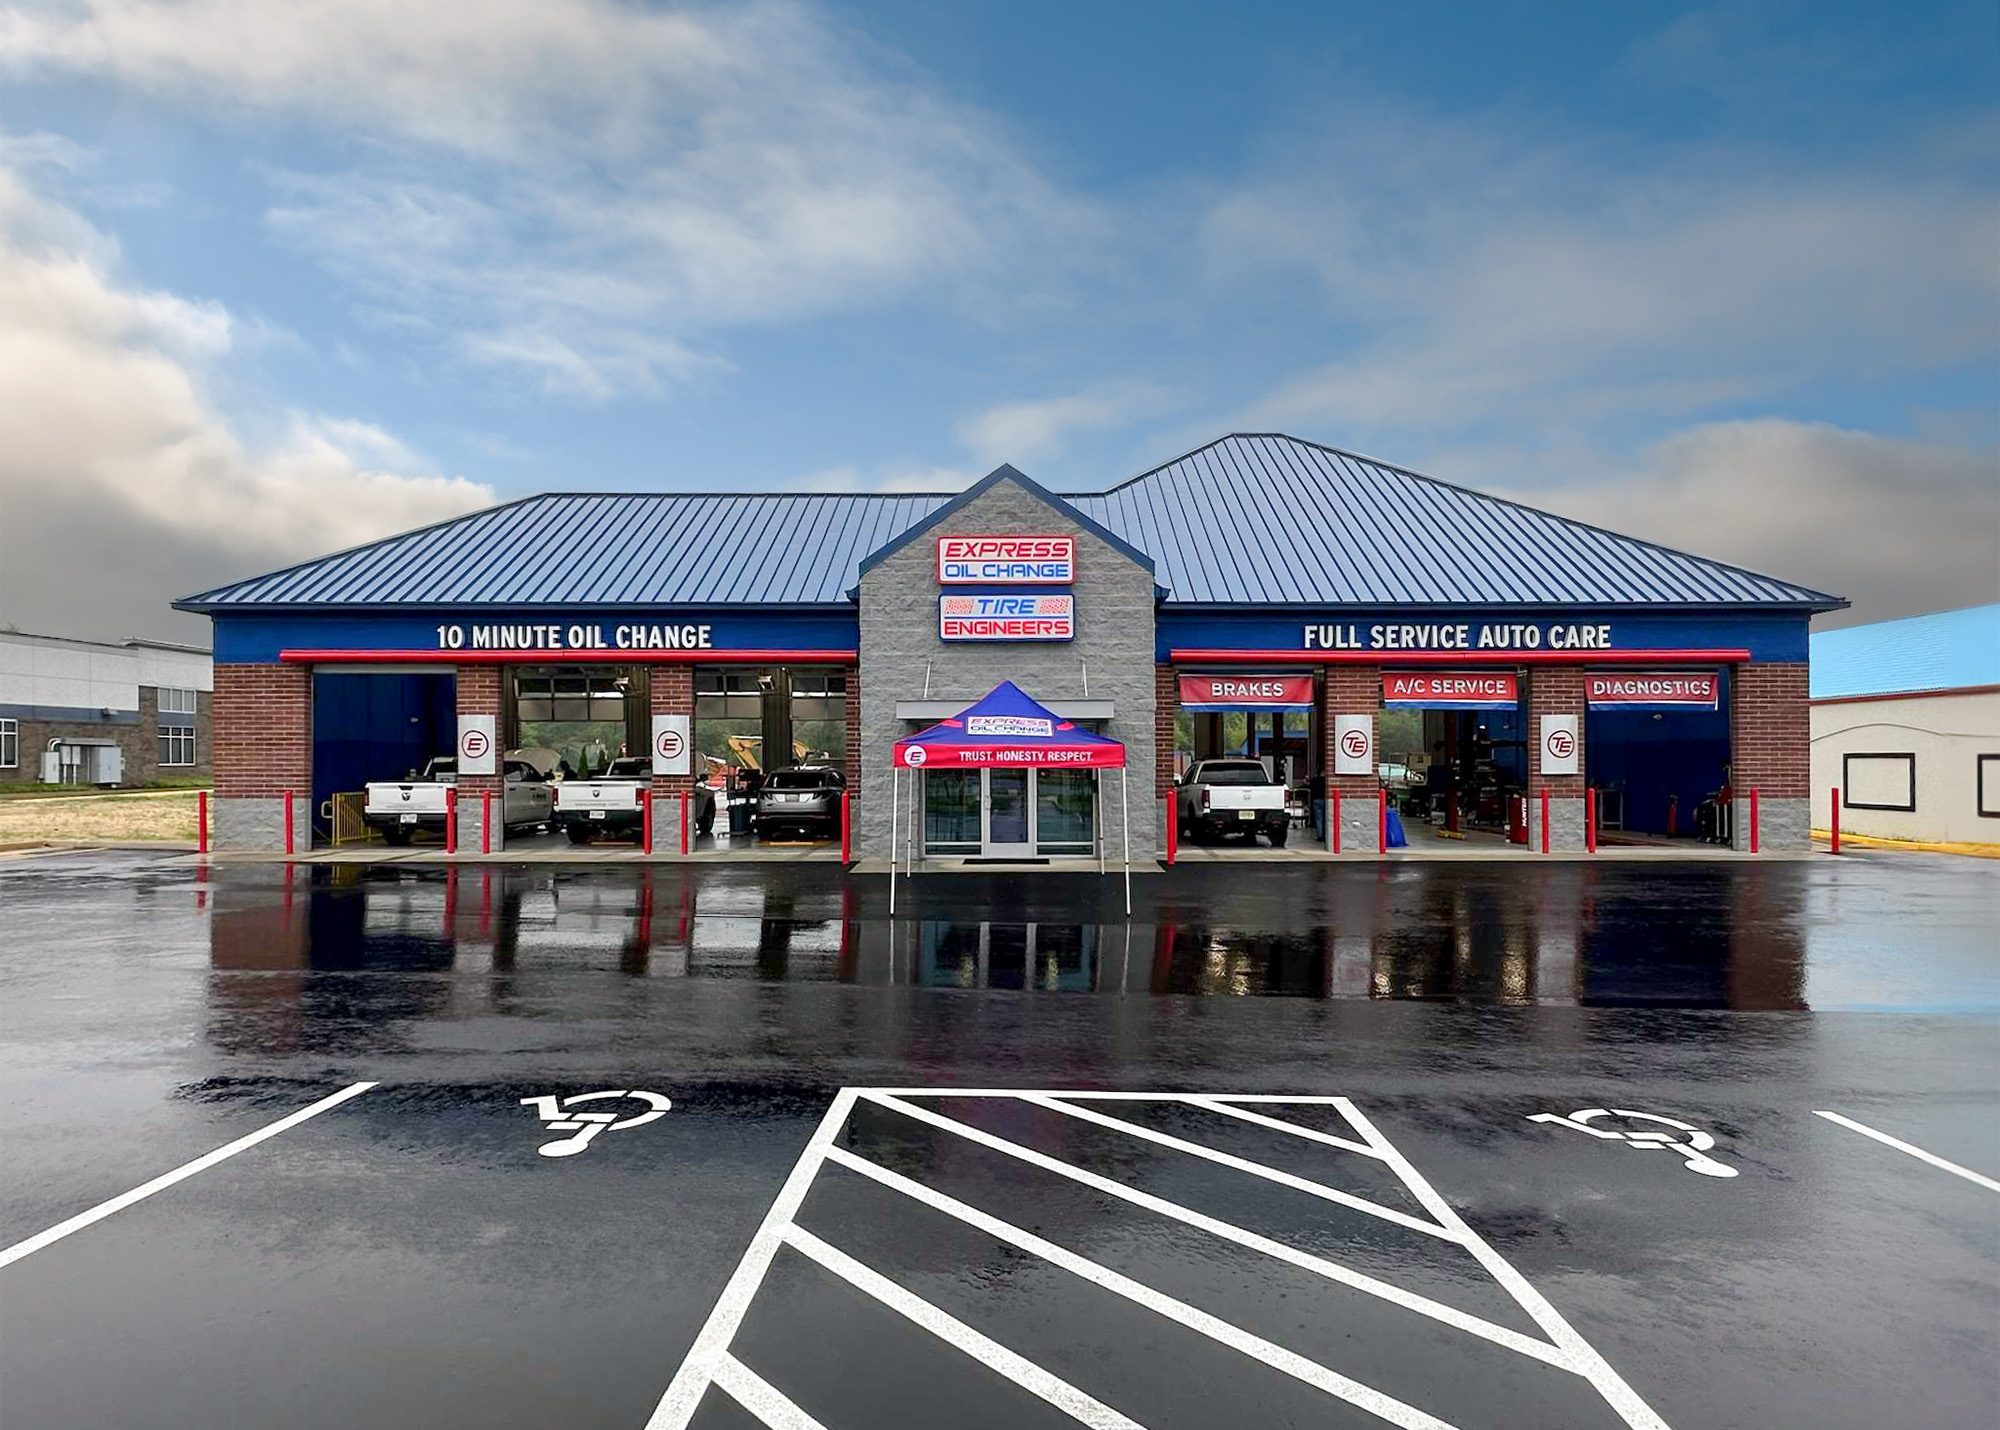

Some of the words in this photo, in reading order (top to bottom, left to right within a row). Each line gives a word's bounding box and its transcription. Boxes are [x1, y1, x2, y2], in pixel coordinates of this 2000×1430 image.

[945, 542, 1069, 557] EXPRESS
[945, 564, 977, 578] OIL
[982, 564, 1069, 578] CHANGE
[977, 599, 1036, 614] TIRE
[945, 621, 1069, 635] ENGINEERS
[437, 625, 463, 649] 10
[472, 625, 562, 649] MINUTE
[568, 625, 607, 649] OIL
[616, 625, 712, 649] CHANGE
[1304, 625, 1362, 648] FULL
[1370, 625, 1469, 648] SERVICE
[1477, 625, 1540, 648] AUTO
[1546, 625, 1611, 649] CARE
[1211, 682, 1284, 697] BRAKES
[1393, 679, 1426, 694] A/C
[1431, 679, 1508, 695] SERVICE
[1593, 680, 1711, 696] DIAGNOSTICS
[971, 718, 1049, 727] EXPRESS
[994, 725, 1049, 733] CHANGE
[959, 751, 994, 761] TRUST.
[996, 751, 1046, 762] HONESTY.
[1047, 751, 1094, 762] RESPECT.
